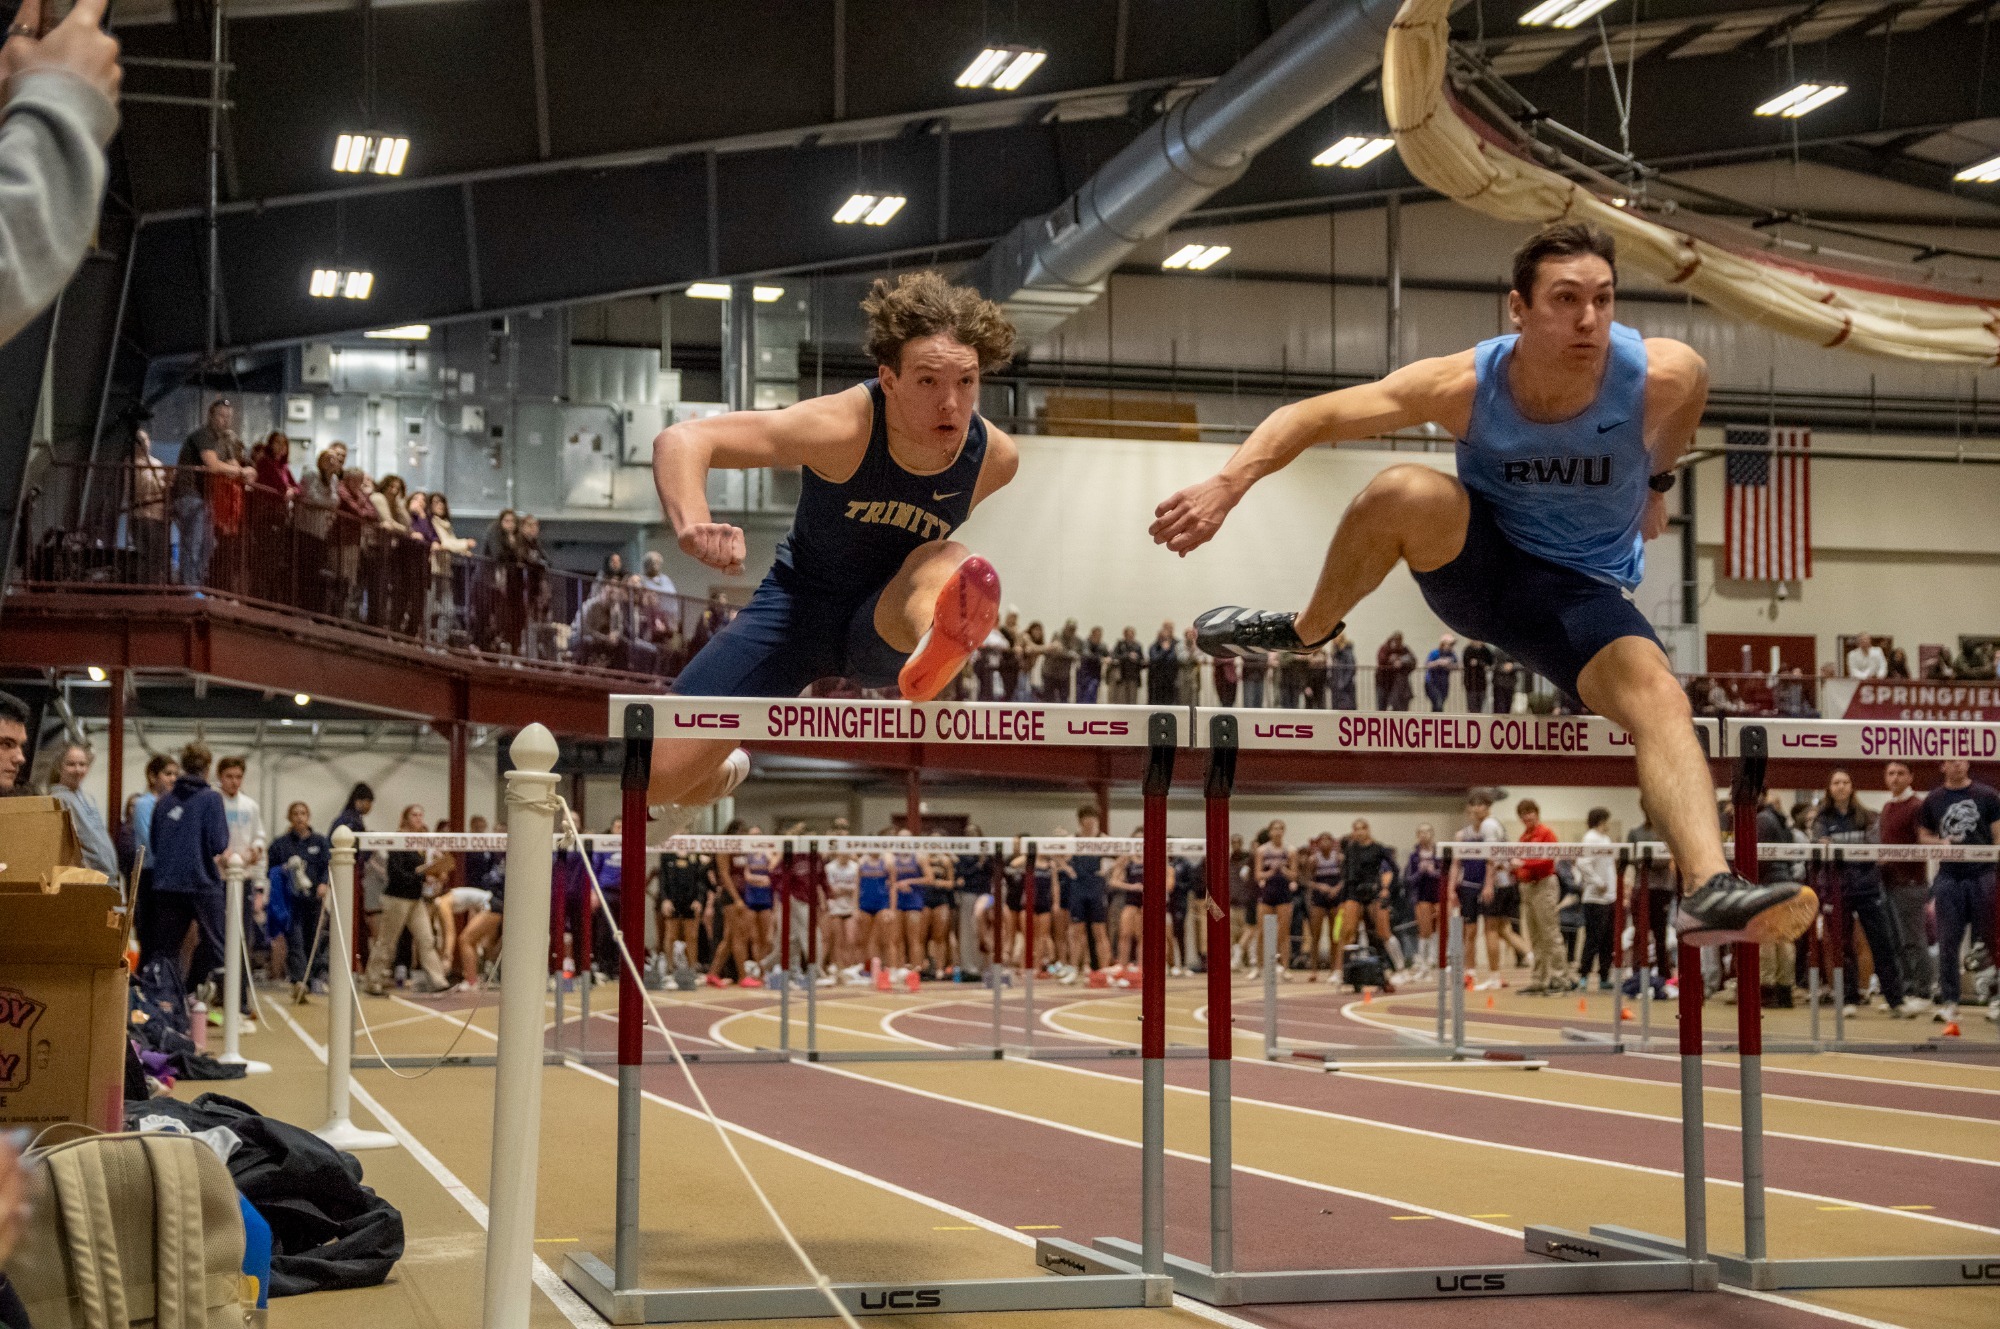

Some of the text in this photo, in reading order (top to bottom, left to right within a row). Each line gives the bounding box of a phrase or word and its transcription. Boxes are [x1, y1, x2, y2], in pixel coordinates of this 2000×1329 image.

[1503, 455, 1612, 487] RWU
[845, 500, 951, 540] TRINITY
[1860, 685, 2000, 708] SPRINGFIEL
[674, 704, 1129, 742] UCS SPRINGFIELD COLLEGE UCS
[1900, 708, 1984, 721] COLLEGE
[1254, 723, 1314, 739] UCS
[1338, 716, 1482, 750] SPRINGFIELD
[1489, 720, 1589, 752] COLLEGE
[1782, 726, 1997, 758] UCS SPRINGFIELD
[404, 836, 468, 848] SPRINGFIELD
[471, 837, 508, 849] COLLEG
[701, 838, 742, 851] COLLEGE
[846, 841, 921, 850] SPRINGFIELD
[922, 842, 971, 851] COLLEGE
[1076, 841, 1131, 853] SPRINGFIELD
[1490, 846, 1544, 857] SPRINGFIELD
[1547, 846, 1584, 857] COLLEGE
[1877, 847, 1927, 858] SPRINGFIELD
[1930, 848, 1965, 859] COLLEGE
[1962, 1264, 2000, 1280] UC
[1436, 1273, 1505, 1292] UCS
[860, 1289, 941, 1310] UCS
